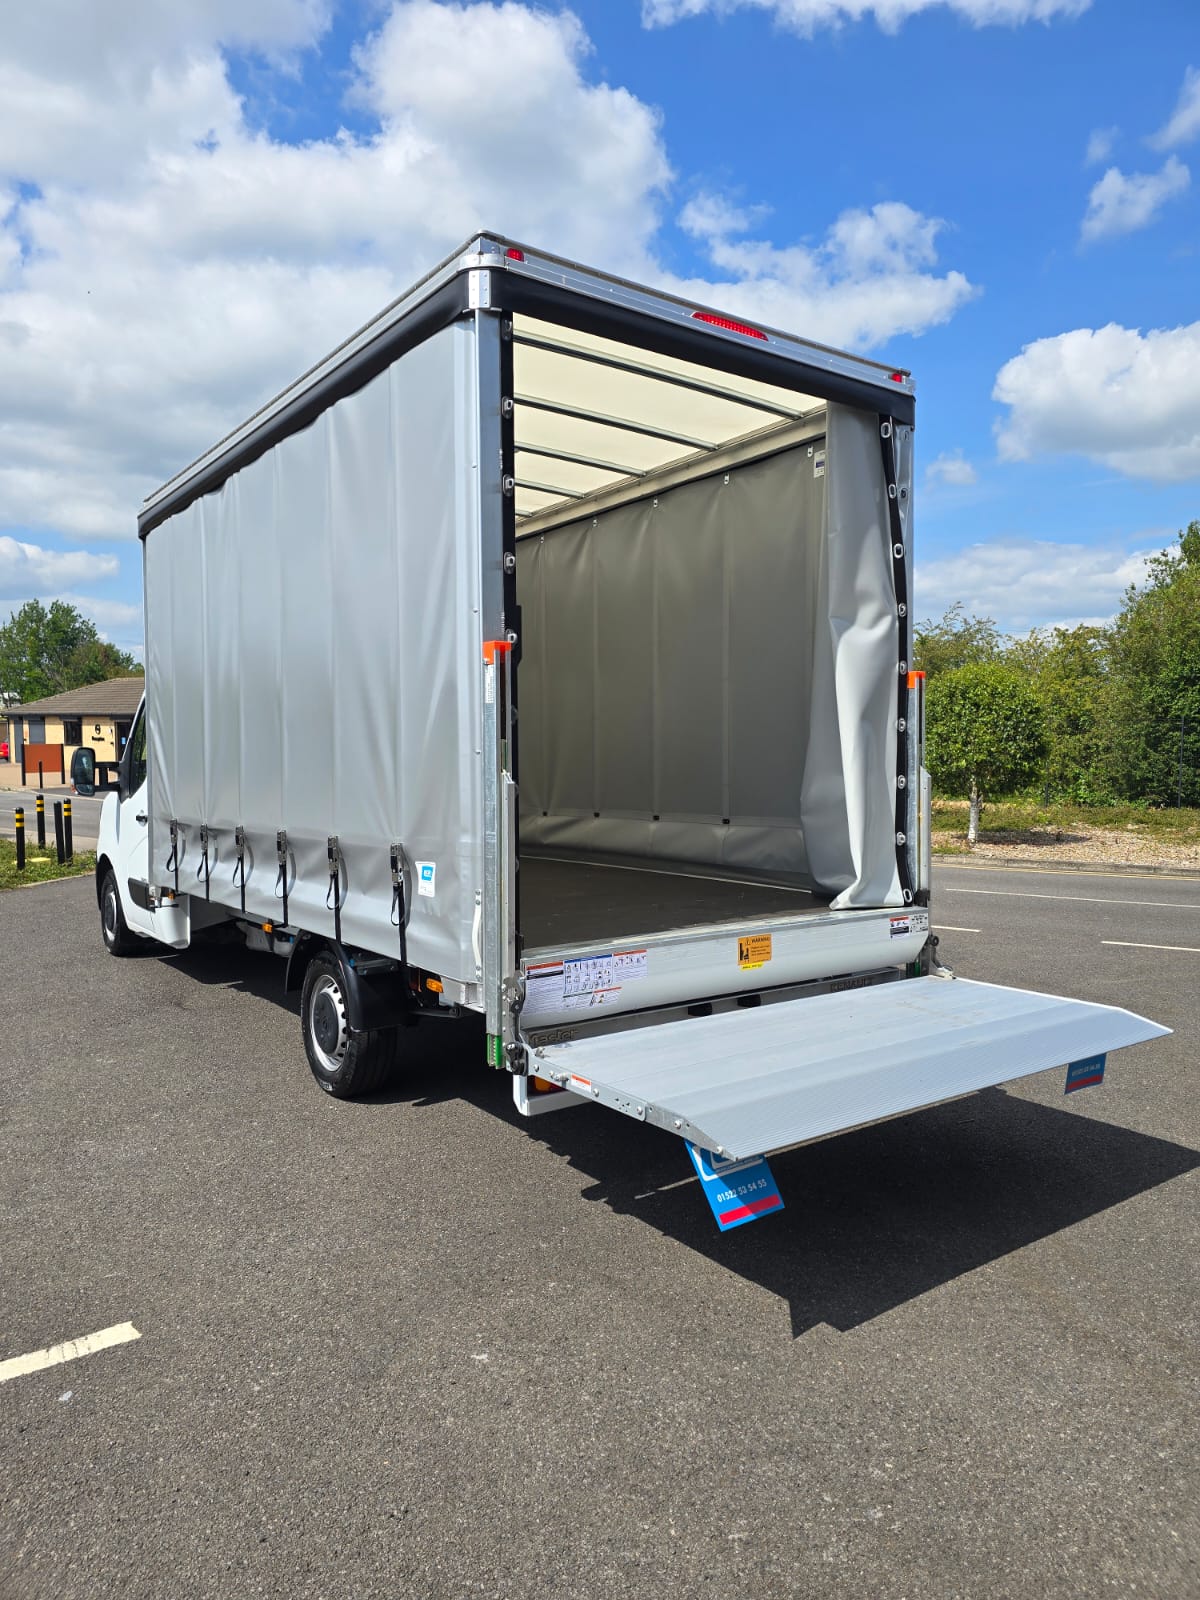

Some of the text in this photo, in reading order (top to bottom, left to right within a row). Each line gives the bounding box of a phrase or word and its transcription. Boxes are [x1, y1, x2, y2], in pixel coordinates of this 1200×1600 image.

[716, 1178, 767, 1202] 01522 53 54 55
